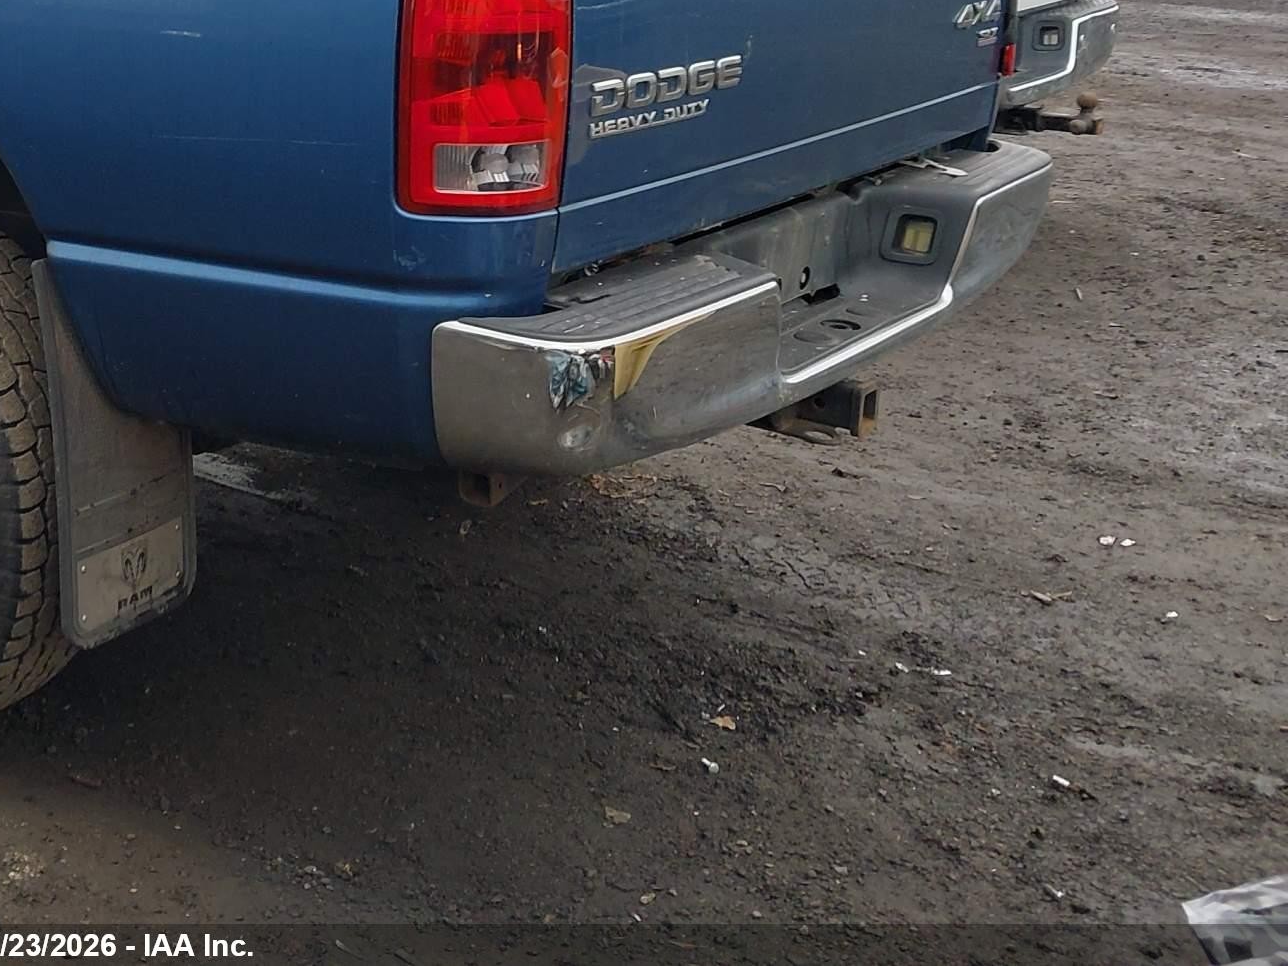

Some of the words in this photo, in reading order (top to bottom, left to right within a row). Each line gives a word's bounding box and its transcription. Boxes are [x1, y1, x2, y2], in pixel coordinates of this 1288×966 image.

[590, 54, 743, 118] DODGE
[589, 111, 657, 138] HEAVY
[663, 98, 710, 122] DUTY
